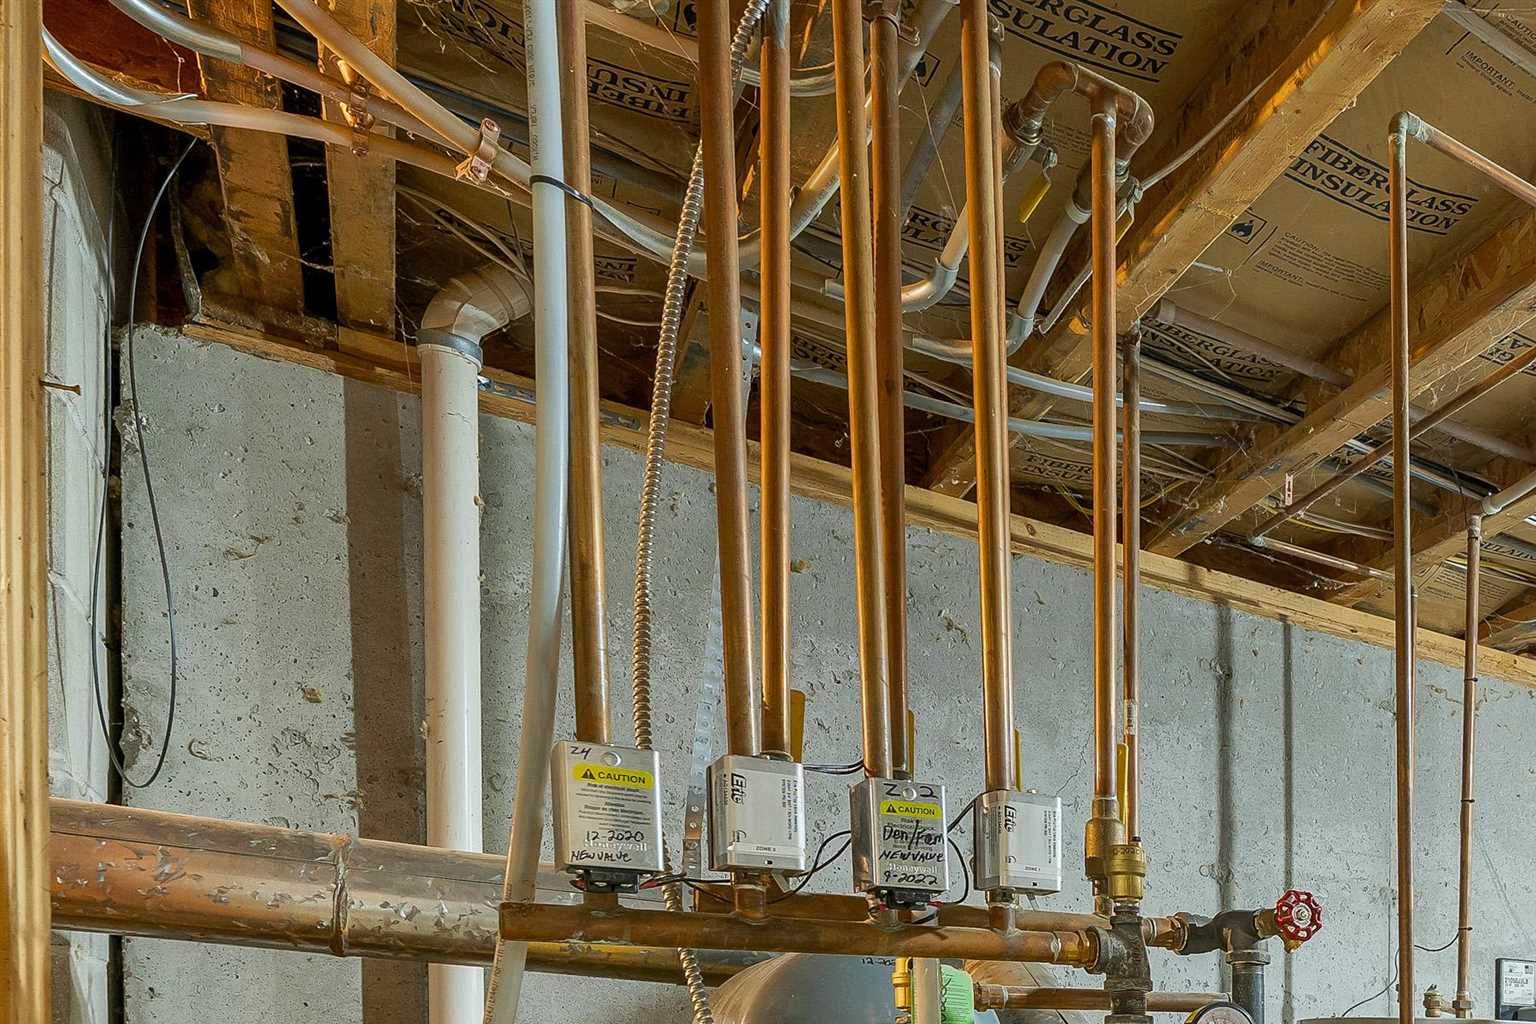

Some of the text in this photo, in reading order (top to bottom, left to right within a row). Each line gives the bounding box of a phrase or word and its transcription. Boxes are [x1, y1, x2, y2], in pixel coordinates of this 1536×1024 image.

[598, 771, 646, 785] CAUTION
[920, 786, 940, 799] 2
[898, 806, 935, 816] CAUTION
